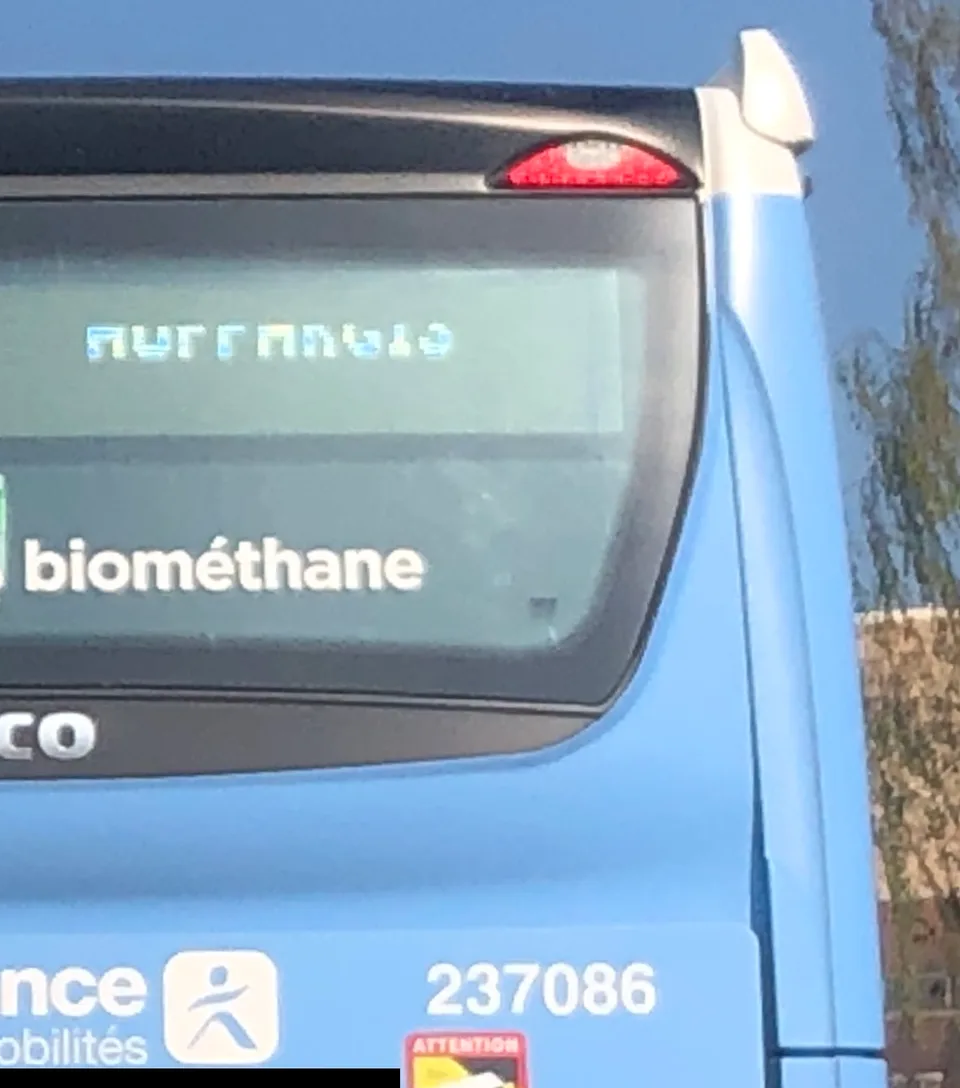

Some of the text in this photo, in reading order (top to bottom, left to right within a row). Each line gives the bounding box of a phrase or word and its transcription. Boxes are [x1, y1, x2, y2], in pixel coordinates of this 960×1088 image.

[25, 537, 425, 592] biométhane
[426, 961, 657, 1017] 237086
[412, 1037, 519, 1054] ATTENTION
